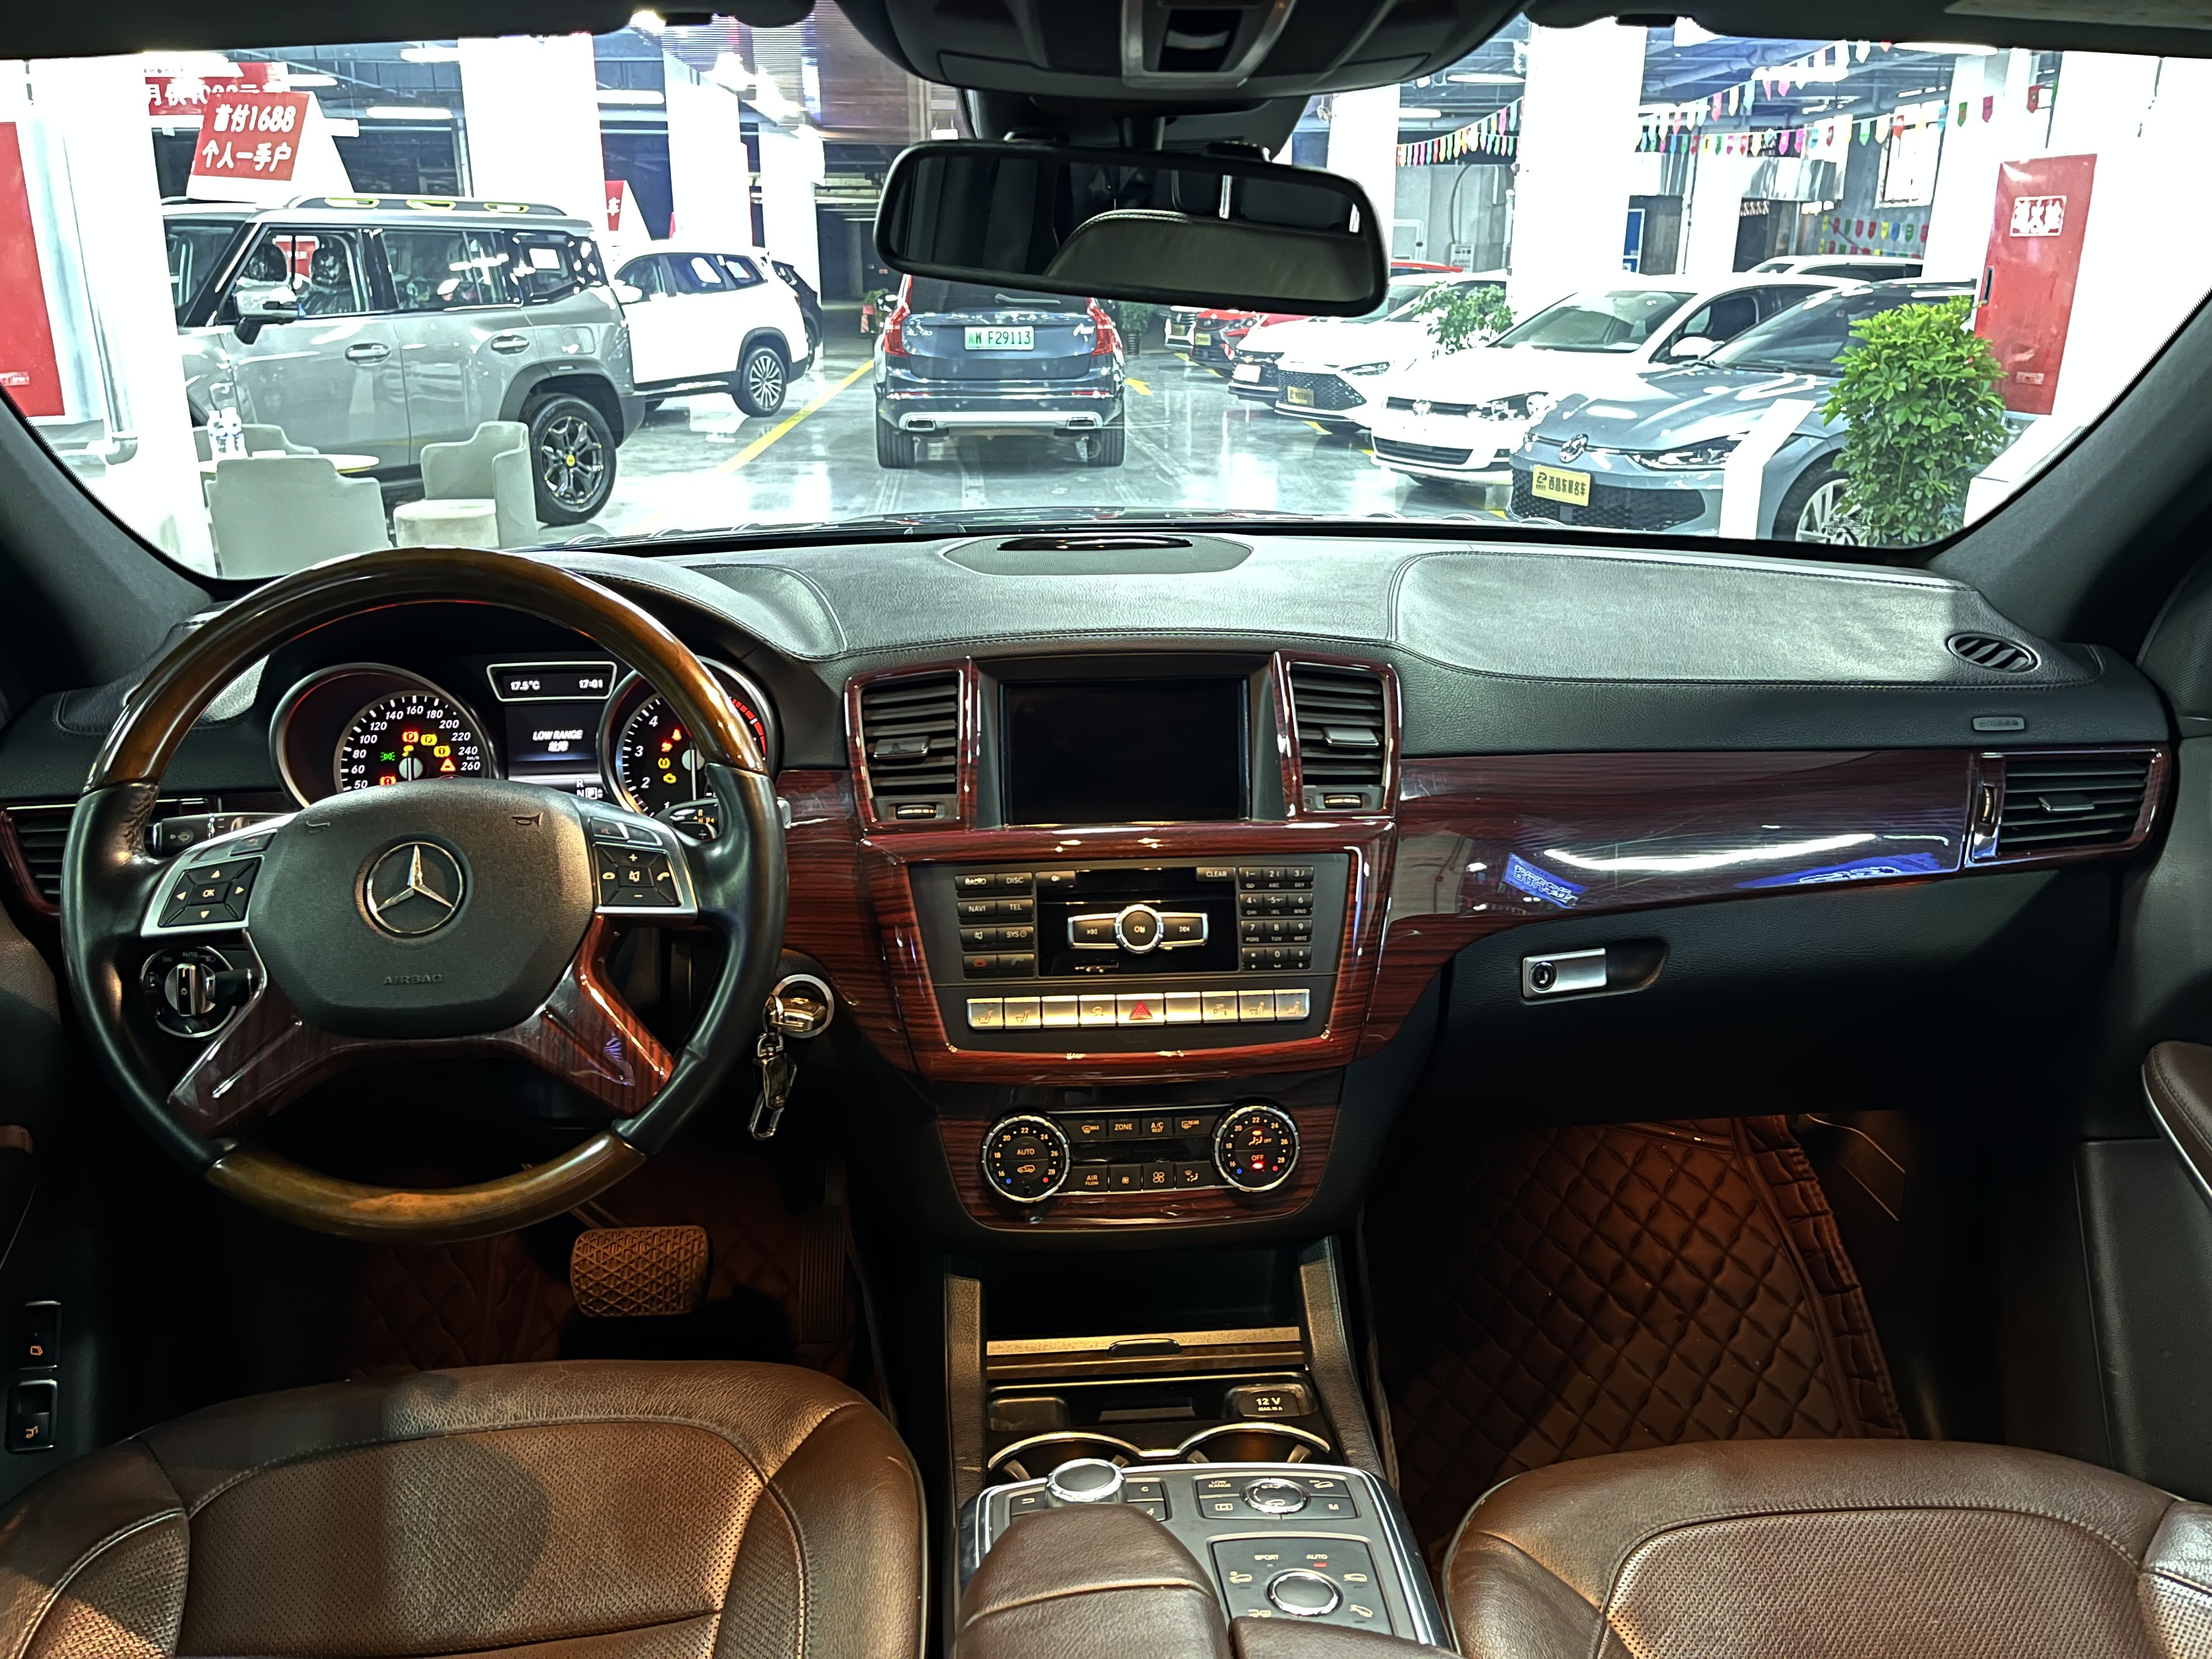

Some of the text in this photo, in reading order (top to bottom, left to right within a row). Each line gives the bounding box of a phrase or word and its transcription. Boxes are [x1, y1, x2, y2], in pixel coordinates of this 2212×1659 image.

[213, 104, 296, 133] 首付1688
[202, 139, 292, 172] 个人一手户
[988, 331, 1031, 345] F29113
[579, 679, 603, 689] 17:01
[407, 706, 424, 714] 160
[426, 709, 443, 719] 180
[386, 711, 404, 720] 140
[370, 721, 387, 731] 120
[439, 720, 459, 729] 200
[648, 715, 658, 727] 4
[360, 735, 377, 744] 100
[451, 732, 471, 741] 220
[533, 730, 583, 741] LOW RANGE
[353, 749, 366, 759] 80
[458, 746, 478, 755] 240
[634, 746, 644, 757] 3
[351, 765, 365, 774] 60
[461, 761, 481, 771] 260
[354, 780, 368, 789] 50
[576, 779, 584, 787] R
[641, 777, 650, 788] 2
[383, 974, 442, 984] AIRBAG
